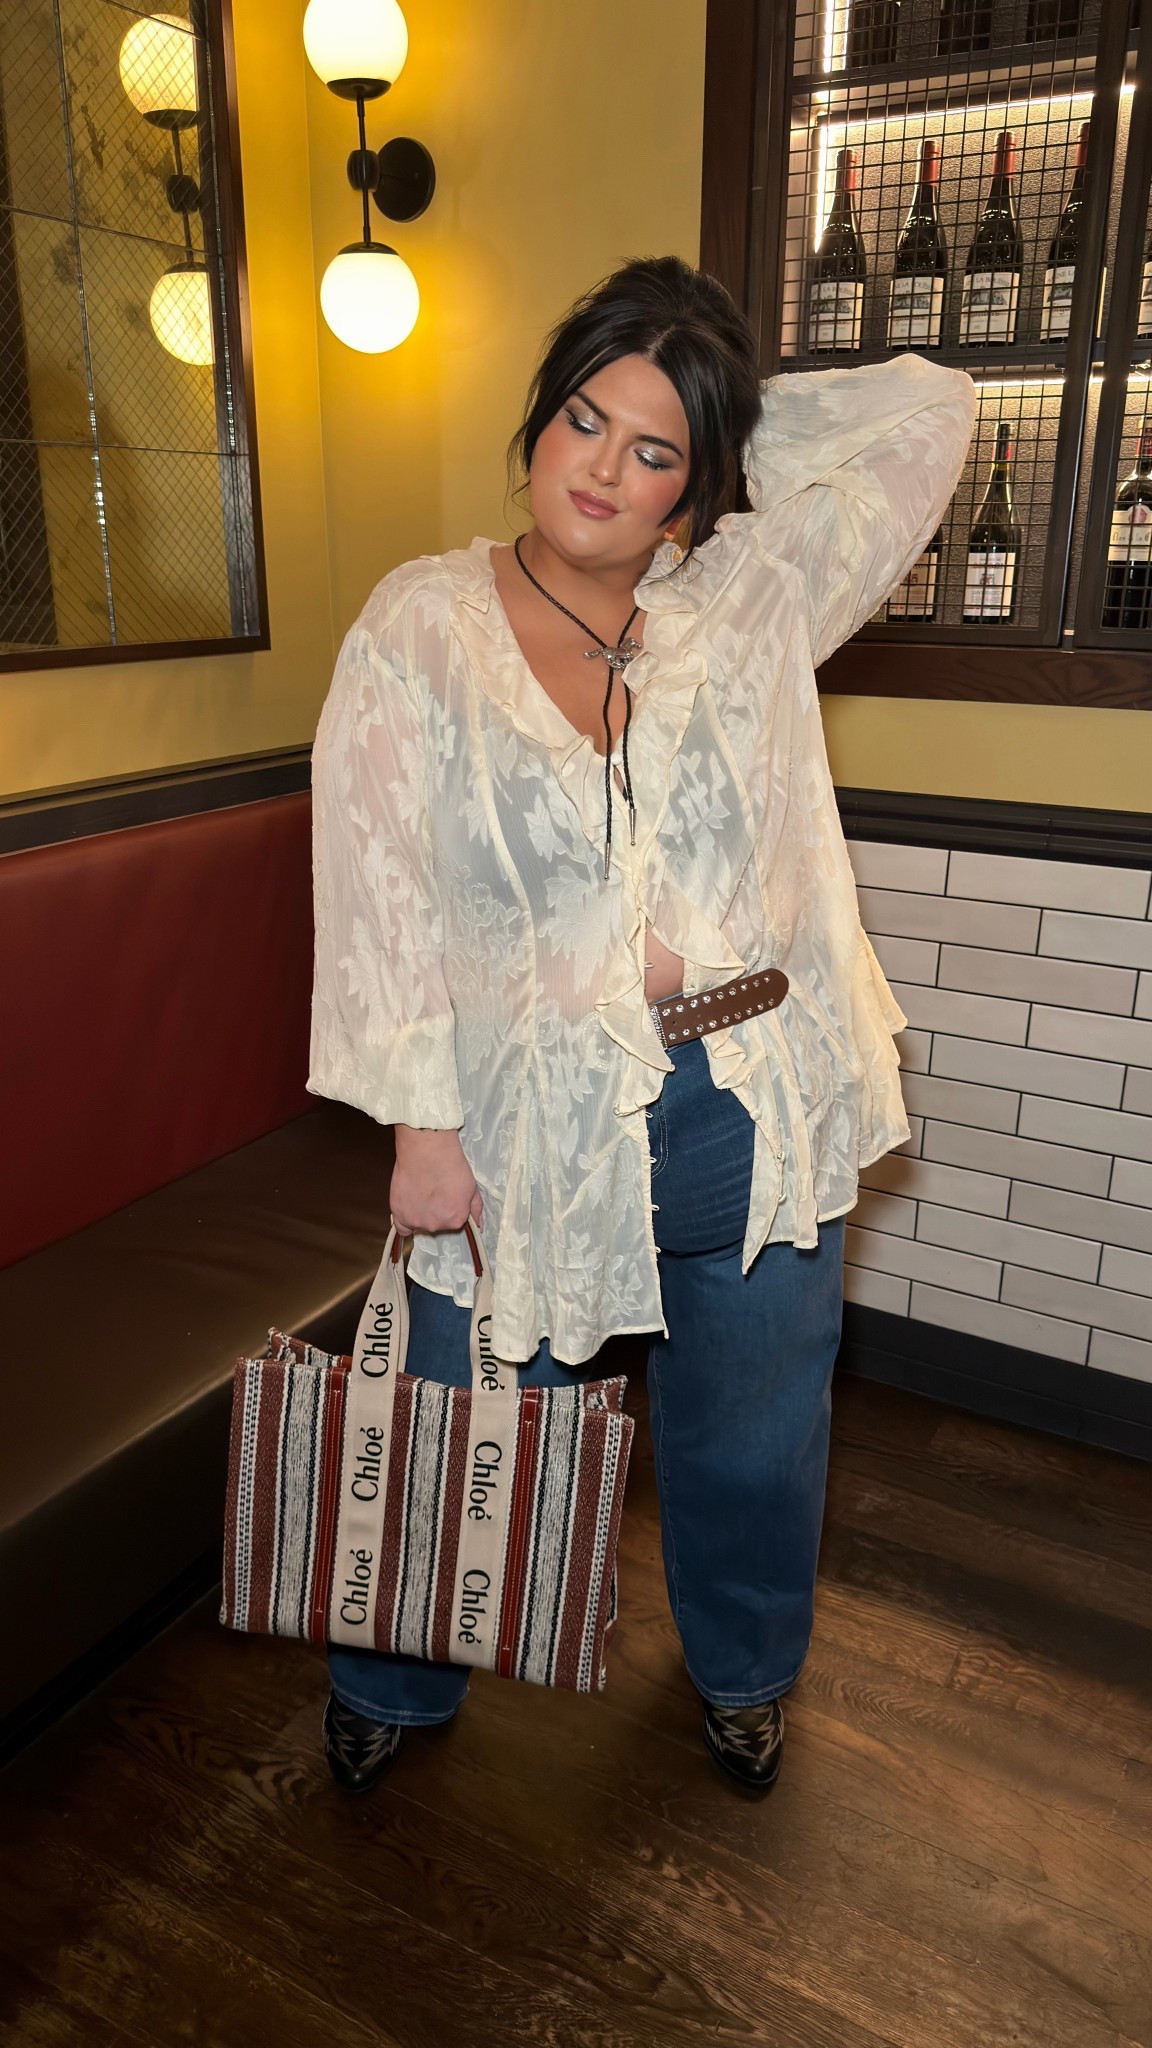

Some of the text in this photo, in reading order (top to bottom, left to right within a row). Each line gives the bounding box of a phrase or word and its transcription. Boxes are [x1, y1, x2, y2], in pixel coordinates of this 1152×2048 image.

[360, 1302, 394, 1378] Chloé
[351, 1426, 385, 1502] Chloé
[467, 1440, 503, 1521] Chloé
[340, 1548, 373, 1626] Chloé
[457, 1568, 491, 1645] Chloé
